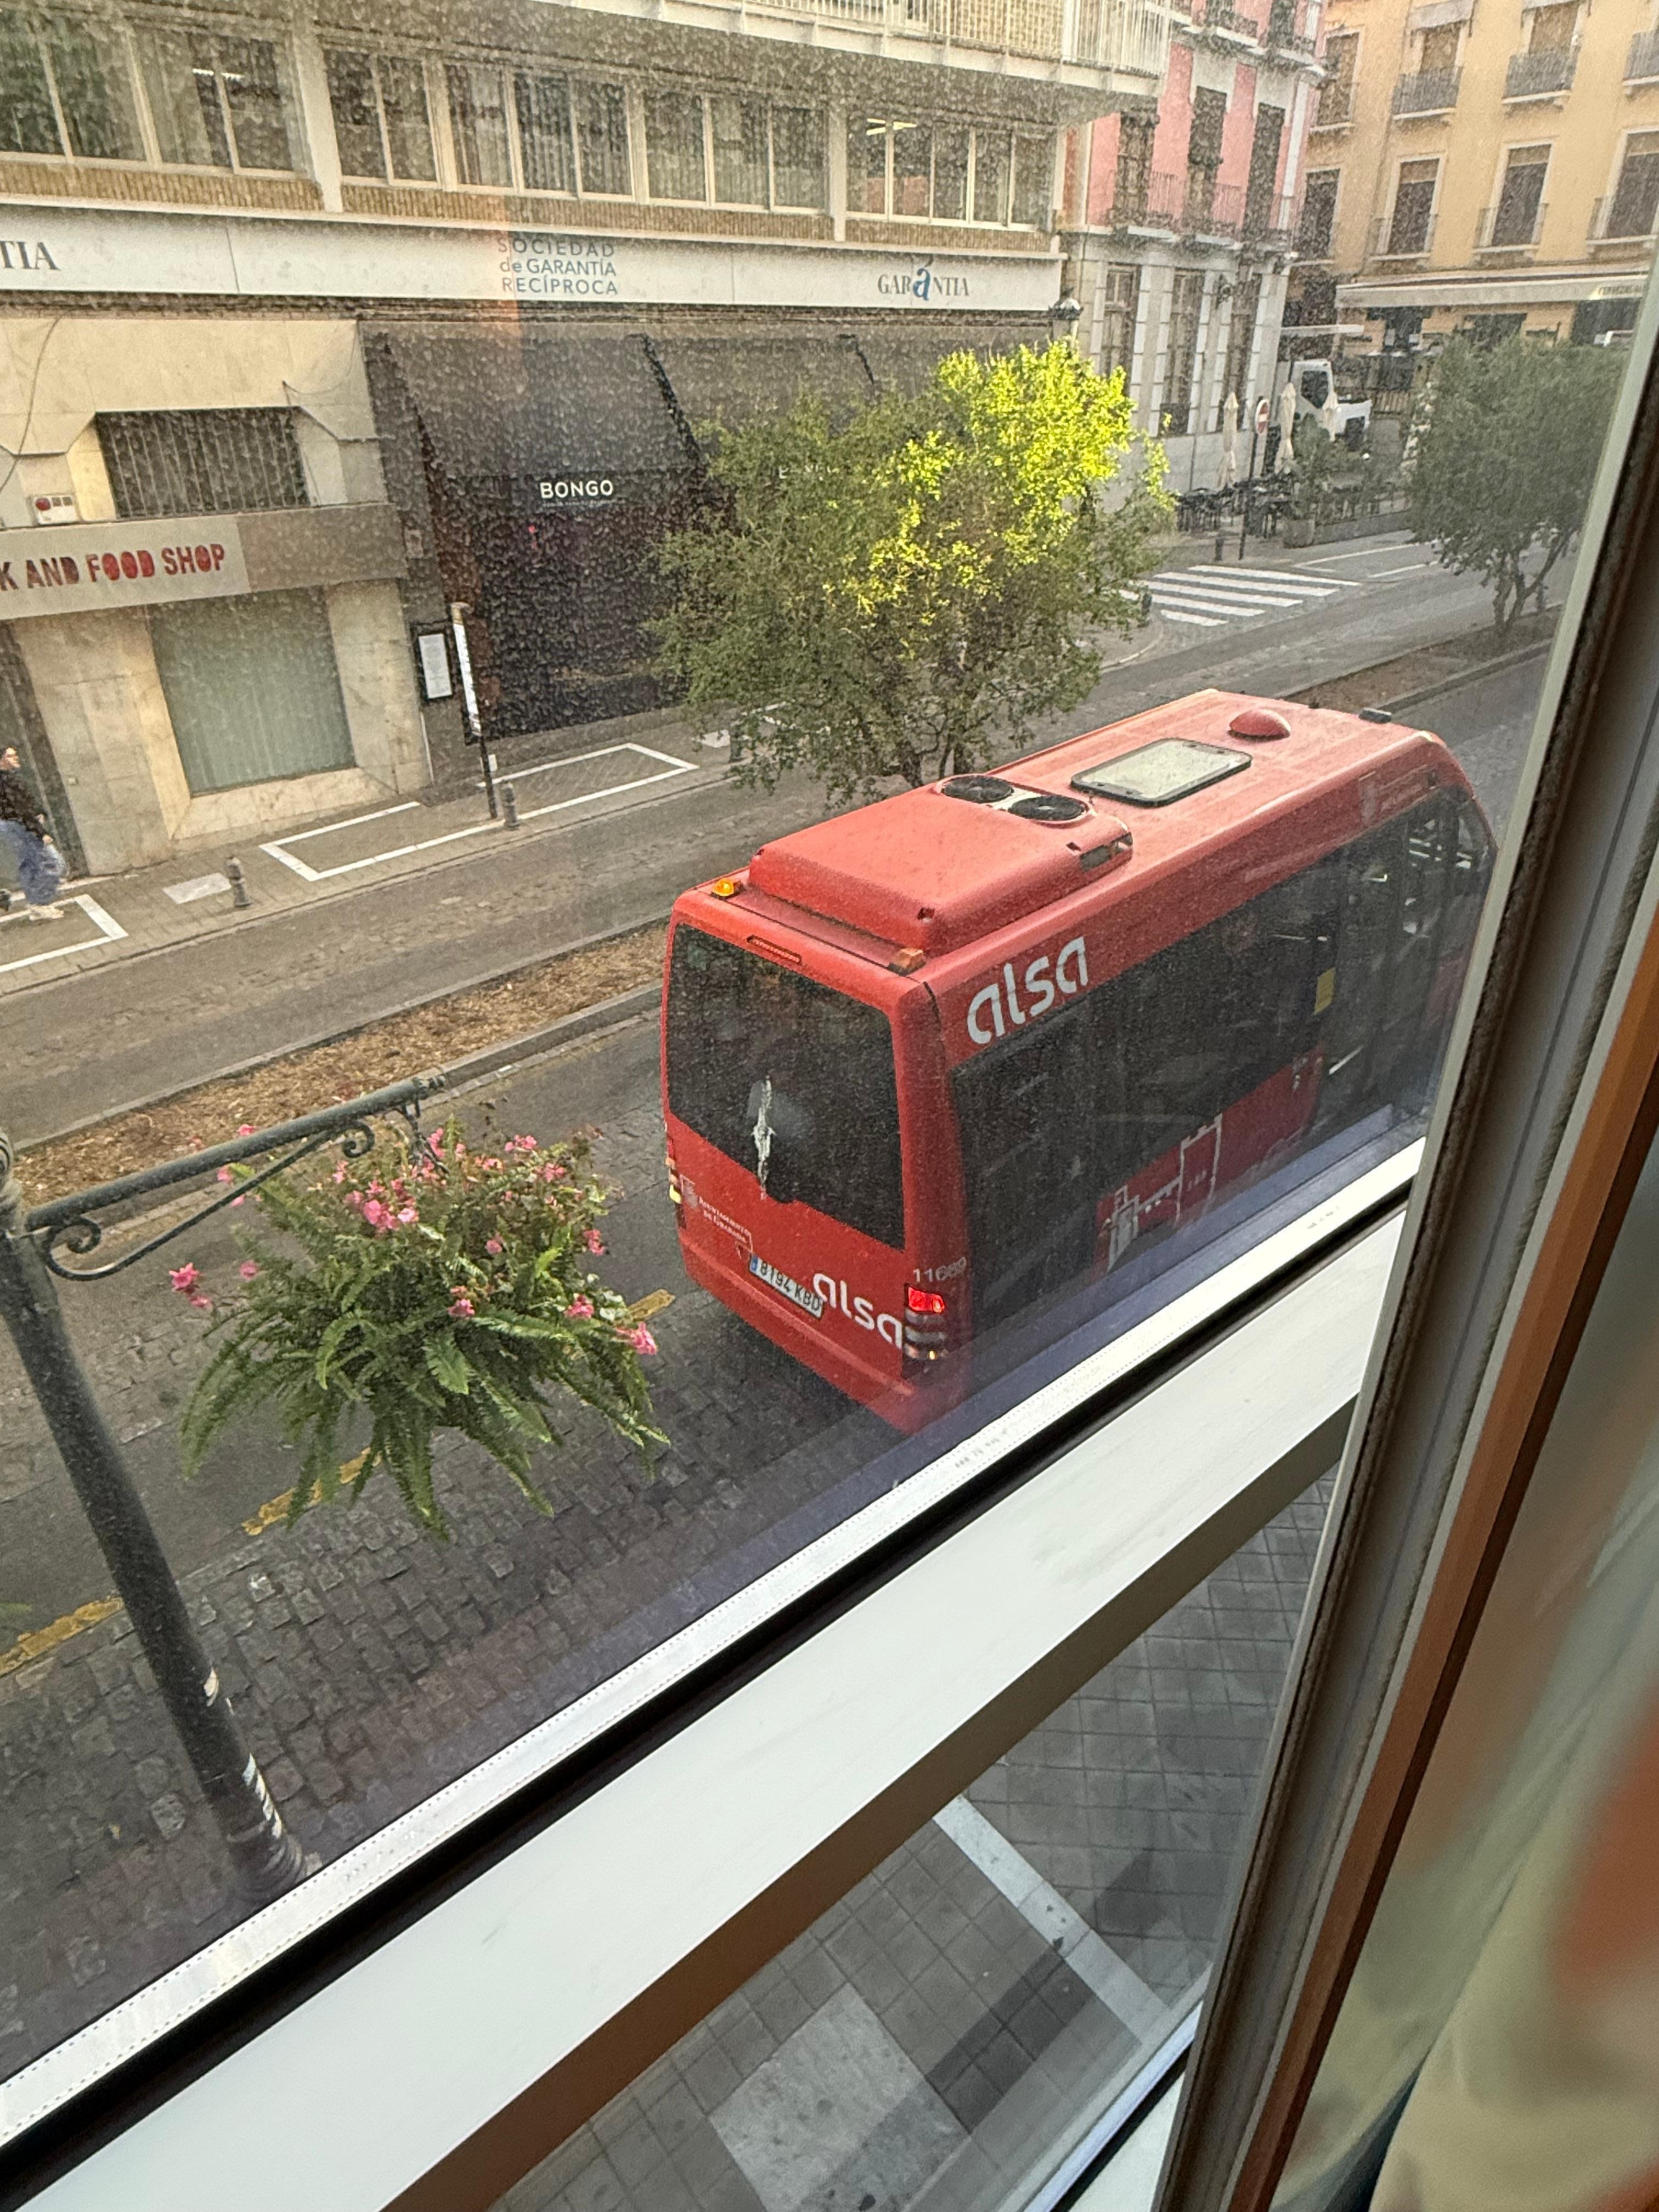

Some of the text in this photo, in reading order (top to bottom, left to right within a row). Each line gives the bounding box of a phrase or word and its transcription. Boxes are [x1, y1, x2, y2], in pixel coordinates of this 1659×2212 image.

[496, 238, 614, 257] SOCIEDAD
[499, 258, 617, 276] de GARANTÍA
[501, 273, 618, 295] RECÍPROCA
[539, 479, 614, 499] BONGO
[26, 556, 80, 589] AND
[86, 550, 155, 582] FOOD
[161, 543, 225, 575] SHOP
[967, 935, 1088, 1045] alsa
[812, 1272, 903, 1350] alsa
